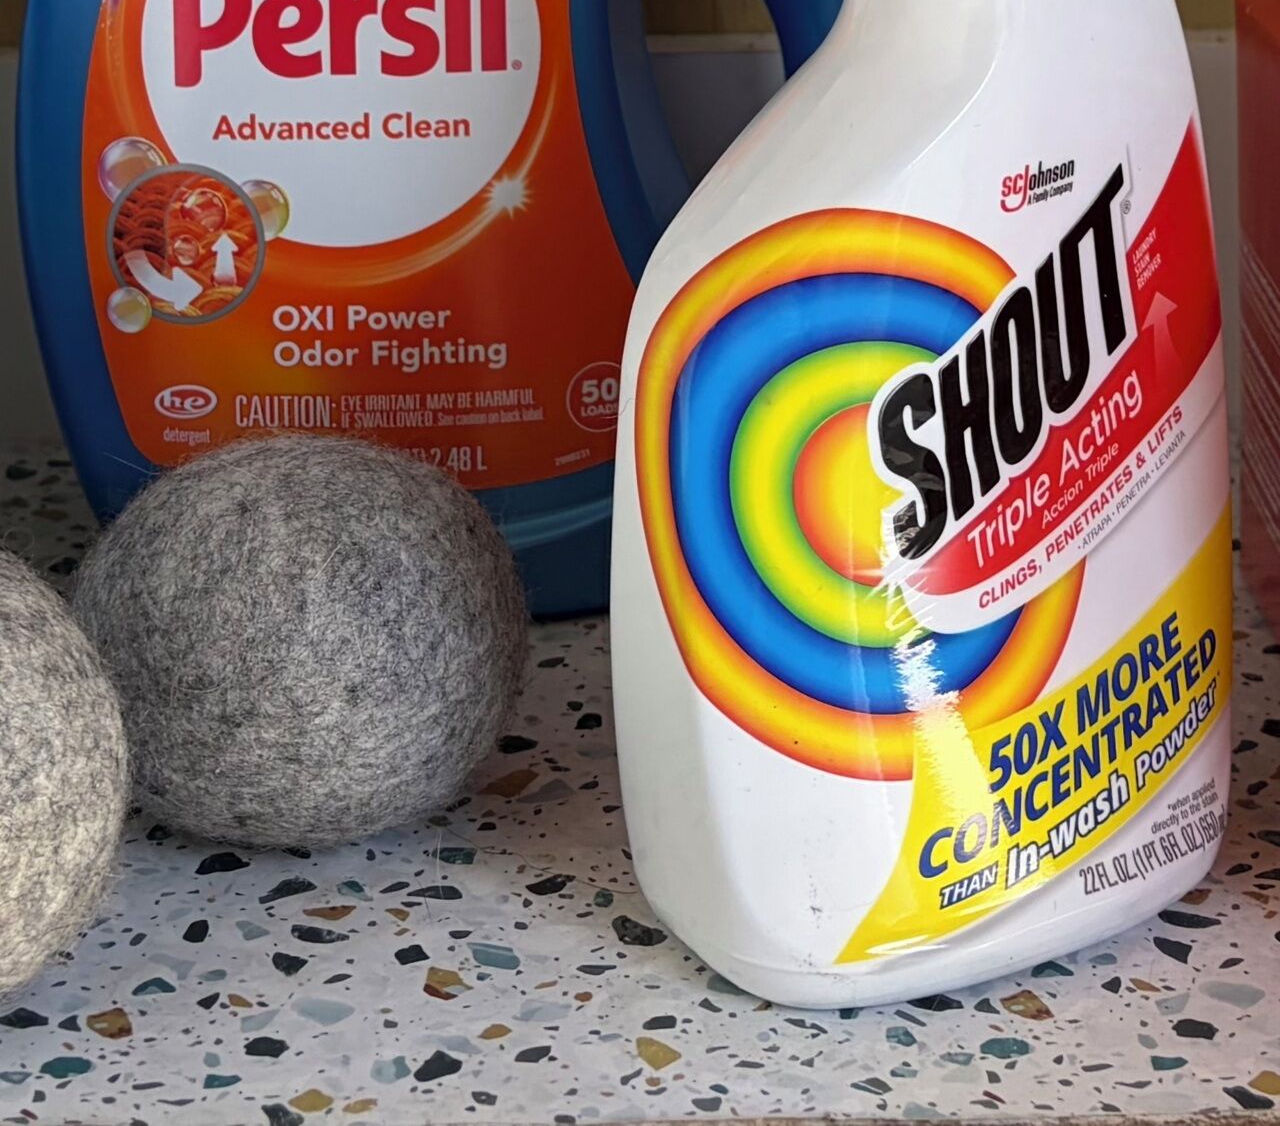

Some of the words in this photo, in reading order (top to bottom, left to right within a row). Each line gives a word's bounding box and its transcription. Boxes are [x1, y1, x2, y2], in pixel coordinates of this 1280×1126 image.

[212, 113, 371, 141] Advanced
[381, 112, 471, 138] Clean
[1132, 227, 1158, 264] LAUNDRY
[1134, 251, 1152, 277] STAIN
[273, 304, 334, 331] OXI
[346, 305, 452, 331] Power
[273, 340, 359, 367] Odor
[370, 338, 508, 373] Fighting
[878, 163, 1127, 561] SHOUT
[235, 394, 337, 428] CAUTION:
[341, 394, 363, 411] EYE
[426, 392, 456, 410] MAY
[457, 391, 472, 408] BE
[475, 388, 535, 407] HARMFUL
[581, 377, 618, 404] 50
[163, 426, 211, 446] detergent
[476, 446, 488, 471] L
[967, 473, 1051, 569] Triple
[1058, 371, 1144, 487] Acting
[1041, 482, 1084, 529] Accion
[1084, 442, 1120, 483] Triple
[978, 557, 1044, 610] CLINGS,
[1045, 464, 1134, 562] PENETRATES
[1135, 450, 1148, 470] &
[1147, 405, 1184, 456] LIFTS
[988, 699, 1067, 795] 50X
[1076, 612, 1183, 735] MORE
[919, 628, 1217, 879] CONCENTRATED
[939, 860, 999, 910] THAN
[1004, 767, 1132, 890] In-wash
[1135, 676, 1218, 793] Powder
